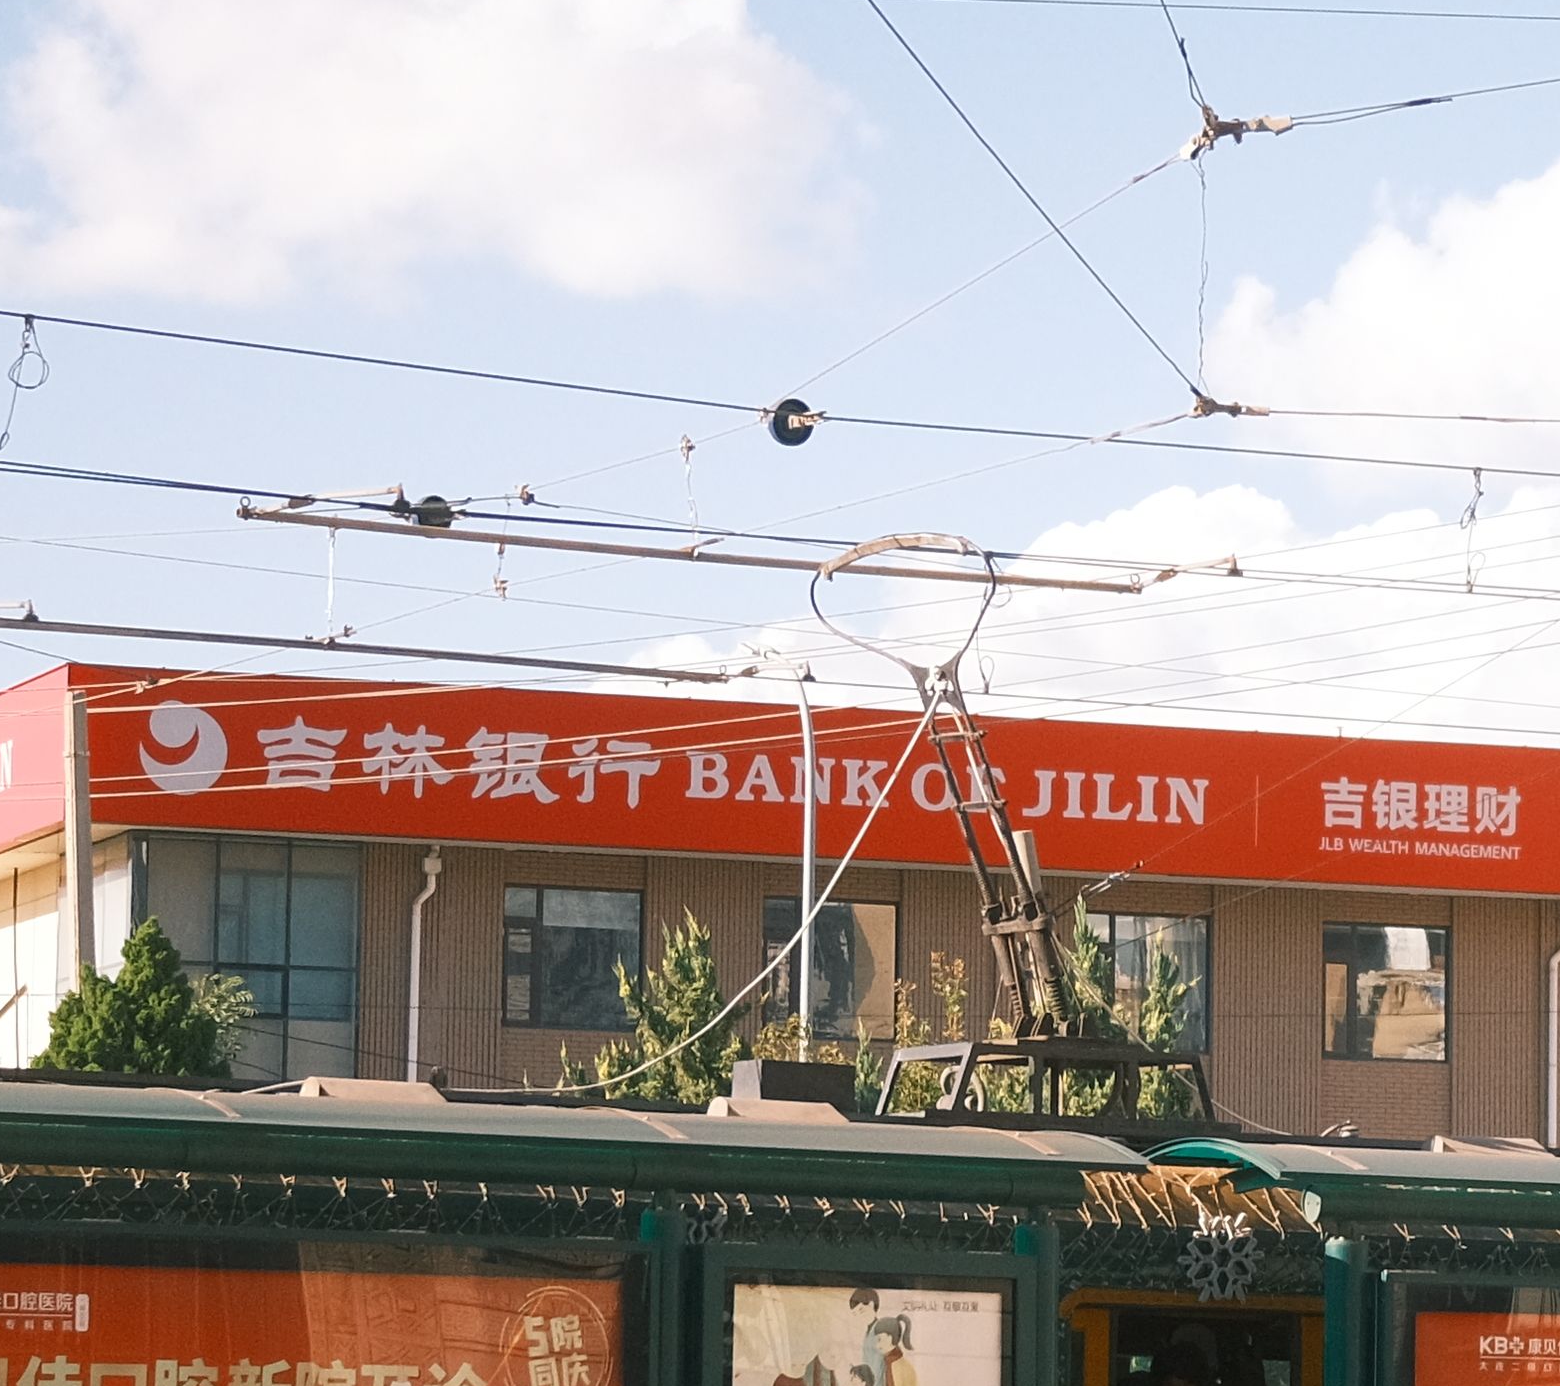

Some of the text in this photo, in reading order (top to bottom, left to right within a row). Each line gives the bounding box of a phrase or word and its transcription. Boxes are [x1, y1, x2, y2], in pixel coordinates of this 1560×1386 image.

[257, 715, 661, 810] 吉林银行
[686, 750, 889, 808] BANK
[1022, 769, 1210, 825] JILIN
[1320, 777, 1521, 837] 吉银理财
[1318, 836, 1522, 861] JLB WEALTH MANAGEMENT
[523, 1314, 583, 1358] 5院
[1479, 1336, 1508, 1354] KB
